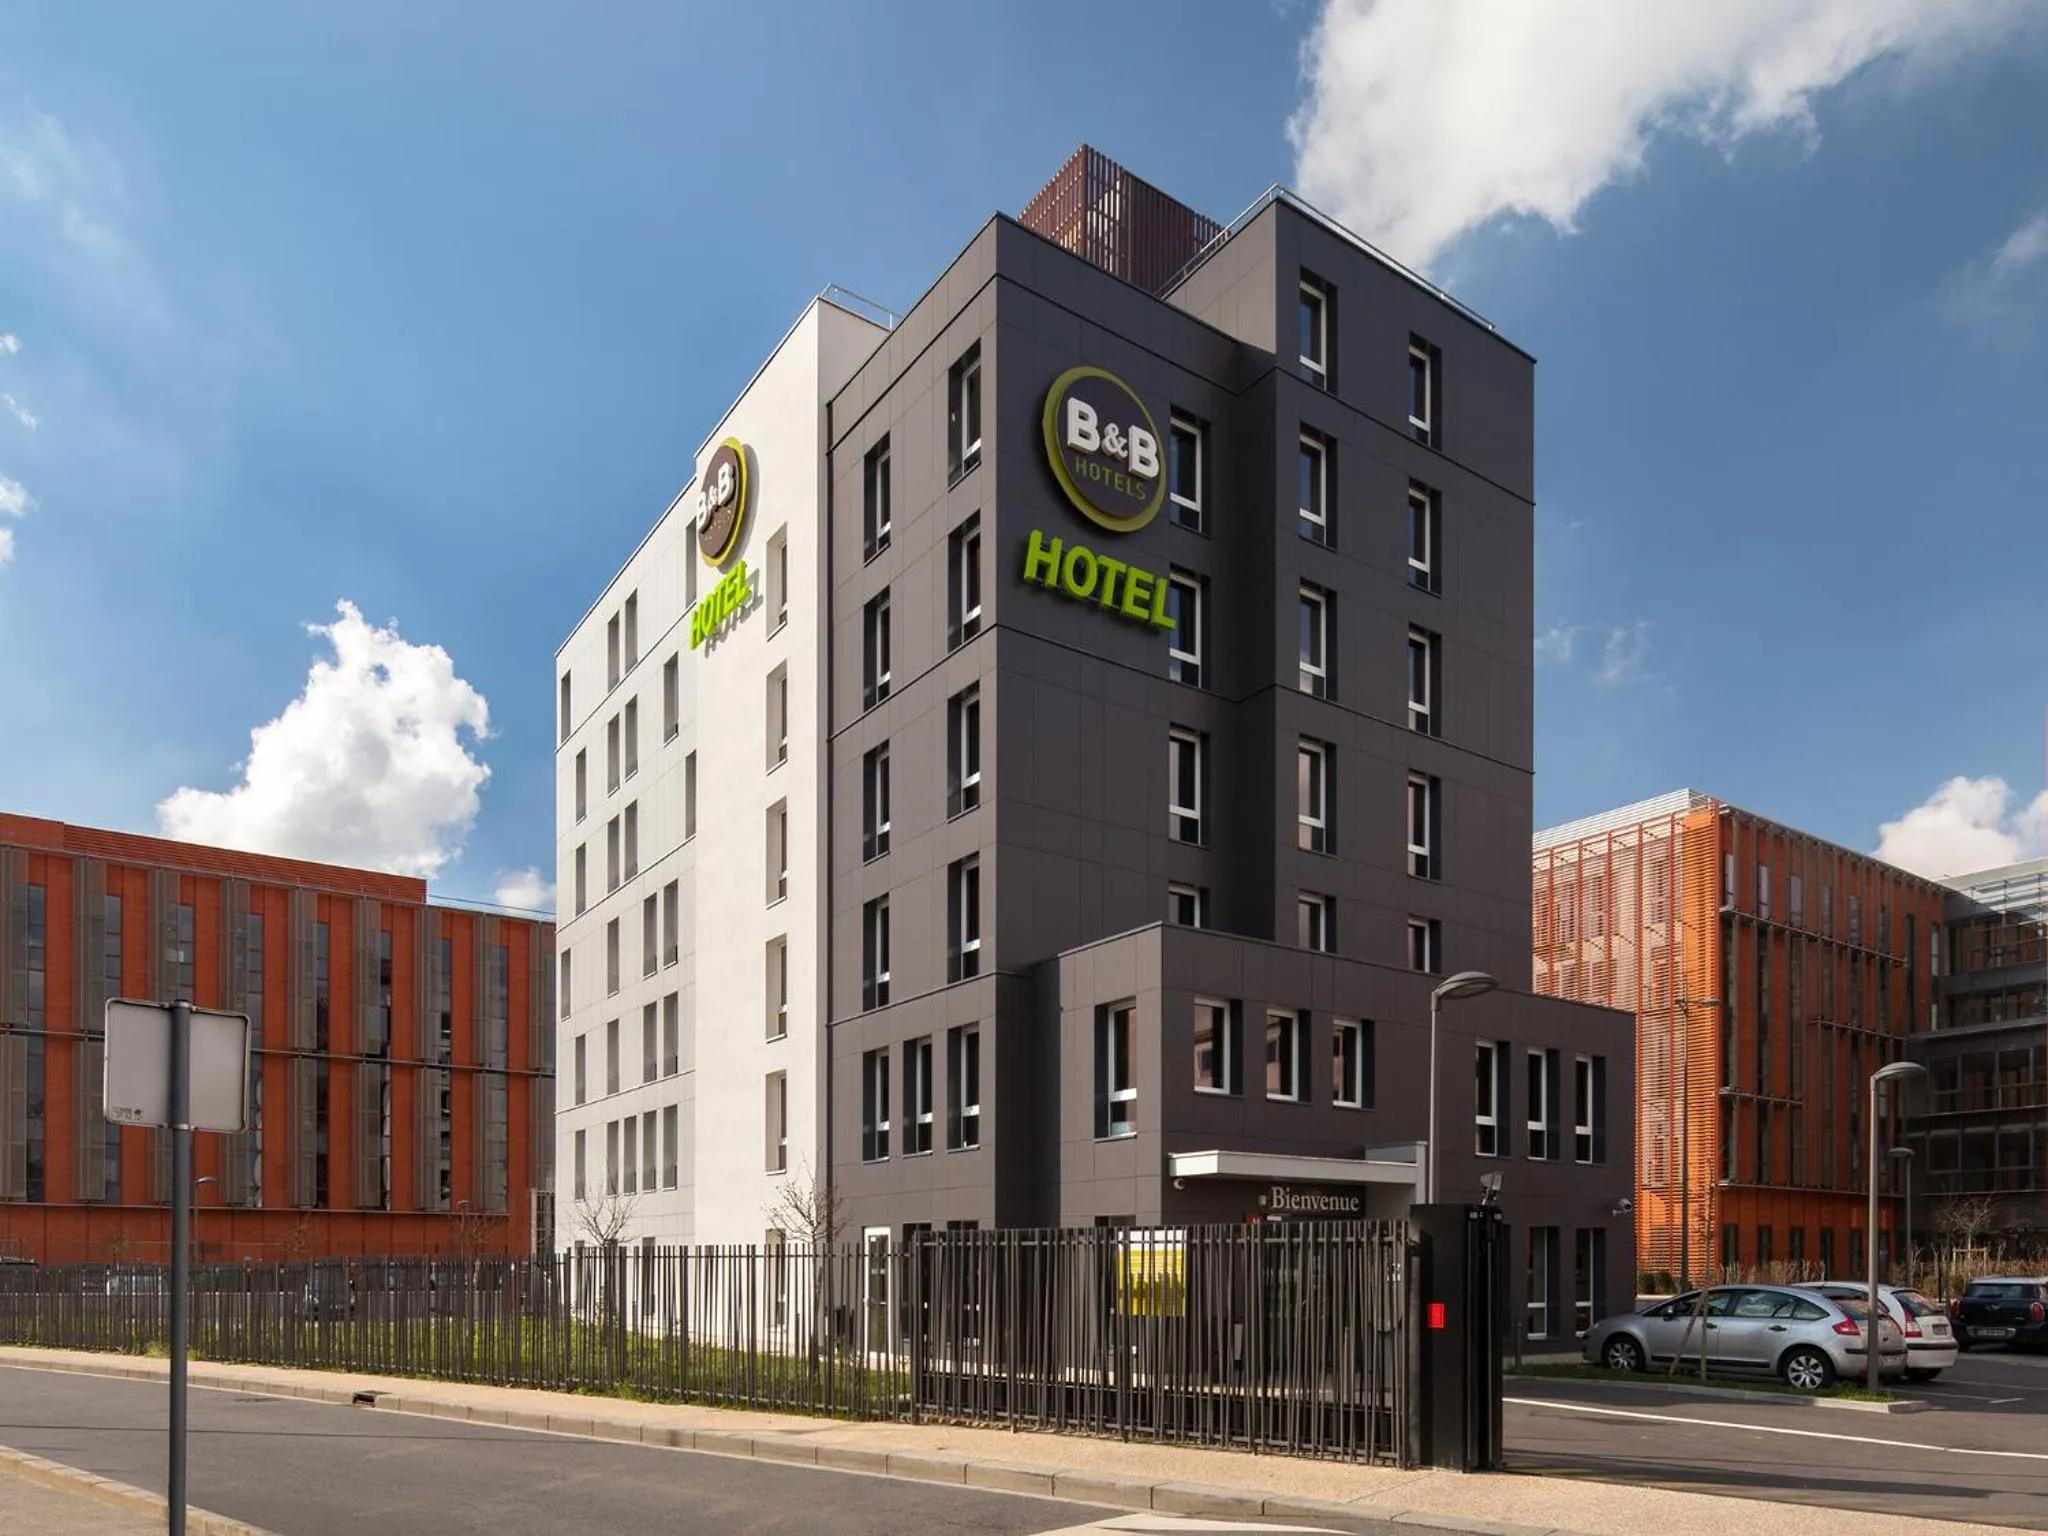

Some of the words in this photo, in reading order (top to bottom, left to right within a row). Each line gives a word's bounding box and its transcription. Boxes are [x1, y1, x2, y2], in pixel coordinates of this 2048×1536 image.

[1067, 397, 1160, 479] B&B
[697, 462, 735, 532] B&B
[1075, 457, 1146, 501] HOTELS
[690, 559, 750, 650] HOTEL
[1024, 529, 1177, 630] HOTEL
[1271, 1186, 1360, 1211] Bienvenue
